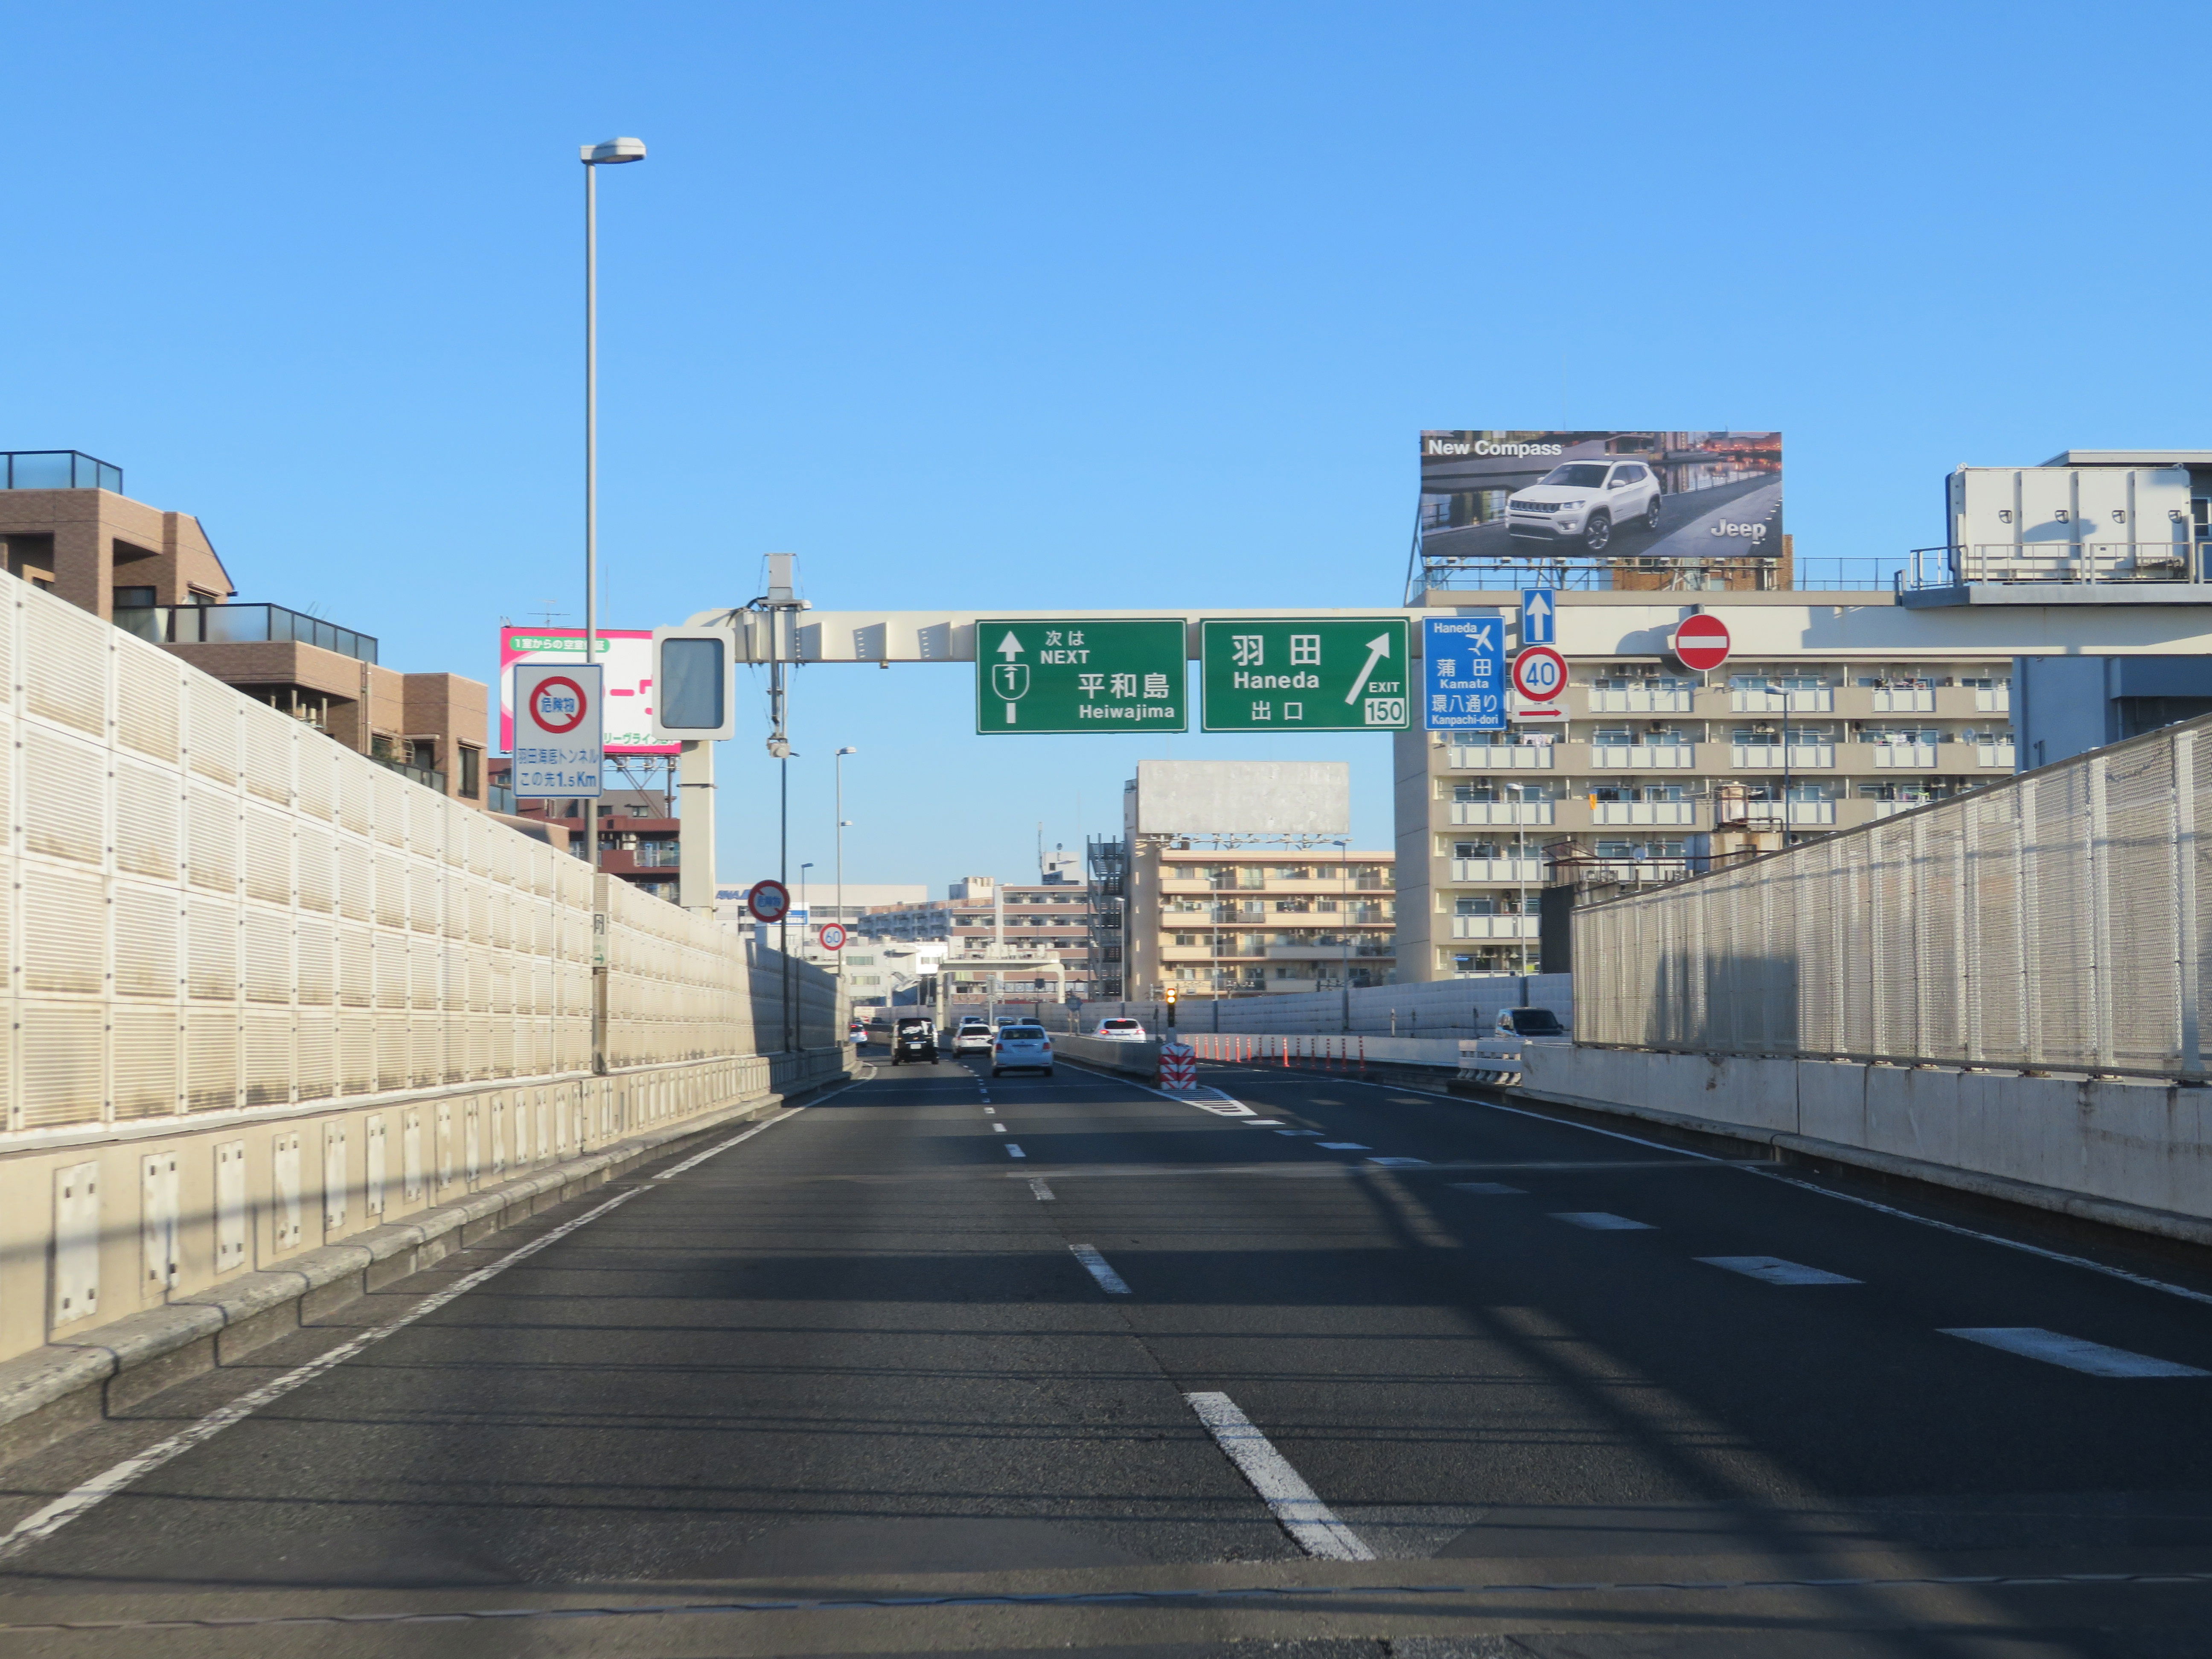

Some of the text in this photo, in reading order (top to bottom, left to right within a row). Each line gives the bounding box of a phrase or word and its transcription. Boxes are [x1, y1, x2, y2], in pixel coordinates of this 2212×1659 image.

[1428, 439, 1563, 458] New Compass
[1711, 518, 1767, 542] Jeep
[1434, 622, 1477, 634] Haneda
[1045, 630, 1085, 646] 次は
[1040, 649, 1091, 664] NEXT
[1231, 634, 1321, 667] 羽田
[1436, 658, 1492, 677] 蒲田
[1526, 662, 1555, 686] 40
[1004, 670, 1016, 690] 1
[1078, 672, 1170, 699] 平和島
[1233, 670, 1320, 689] Haneda
[1368, 681, 1400, 693] EXIT
[1440, 678, 1489, 689] Kamata
[541, 697, 575, 713] 危険物
[1079, 704, 1175, 721] Heiwajima
[1252, 700, 1303, 721] 出口
[1367, 701, 1403, 722] 150
[1431, 694, 1498, 713] 環八通り
[1431, 714, 1499, 726] Kanpachi-dori
[518, 748, 598, 765] 羽田海底トンネル
[825, 931, 841, 943] 60
